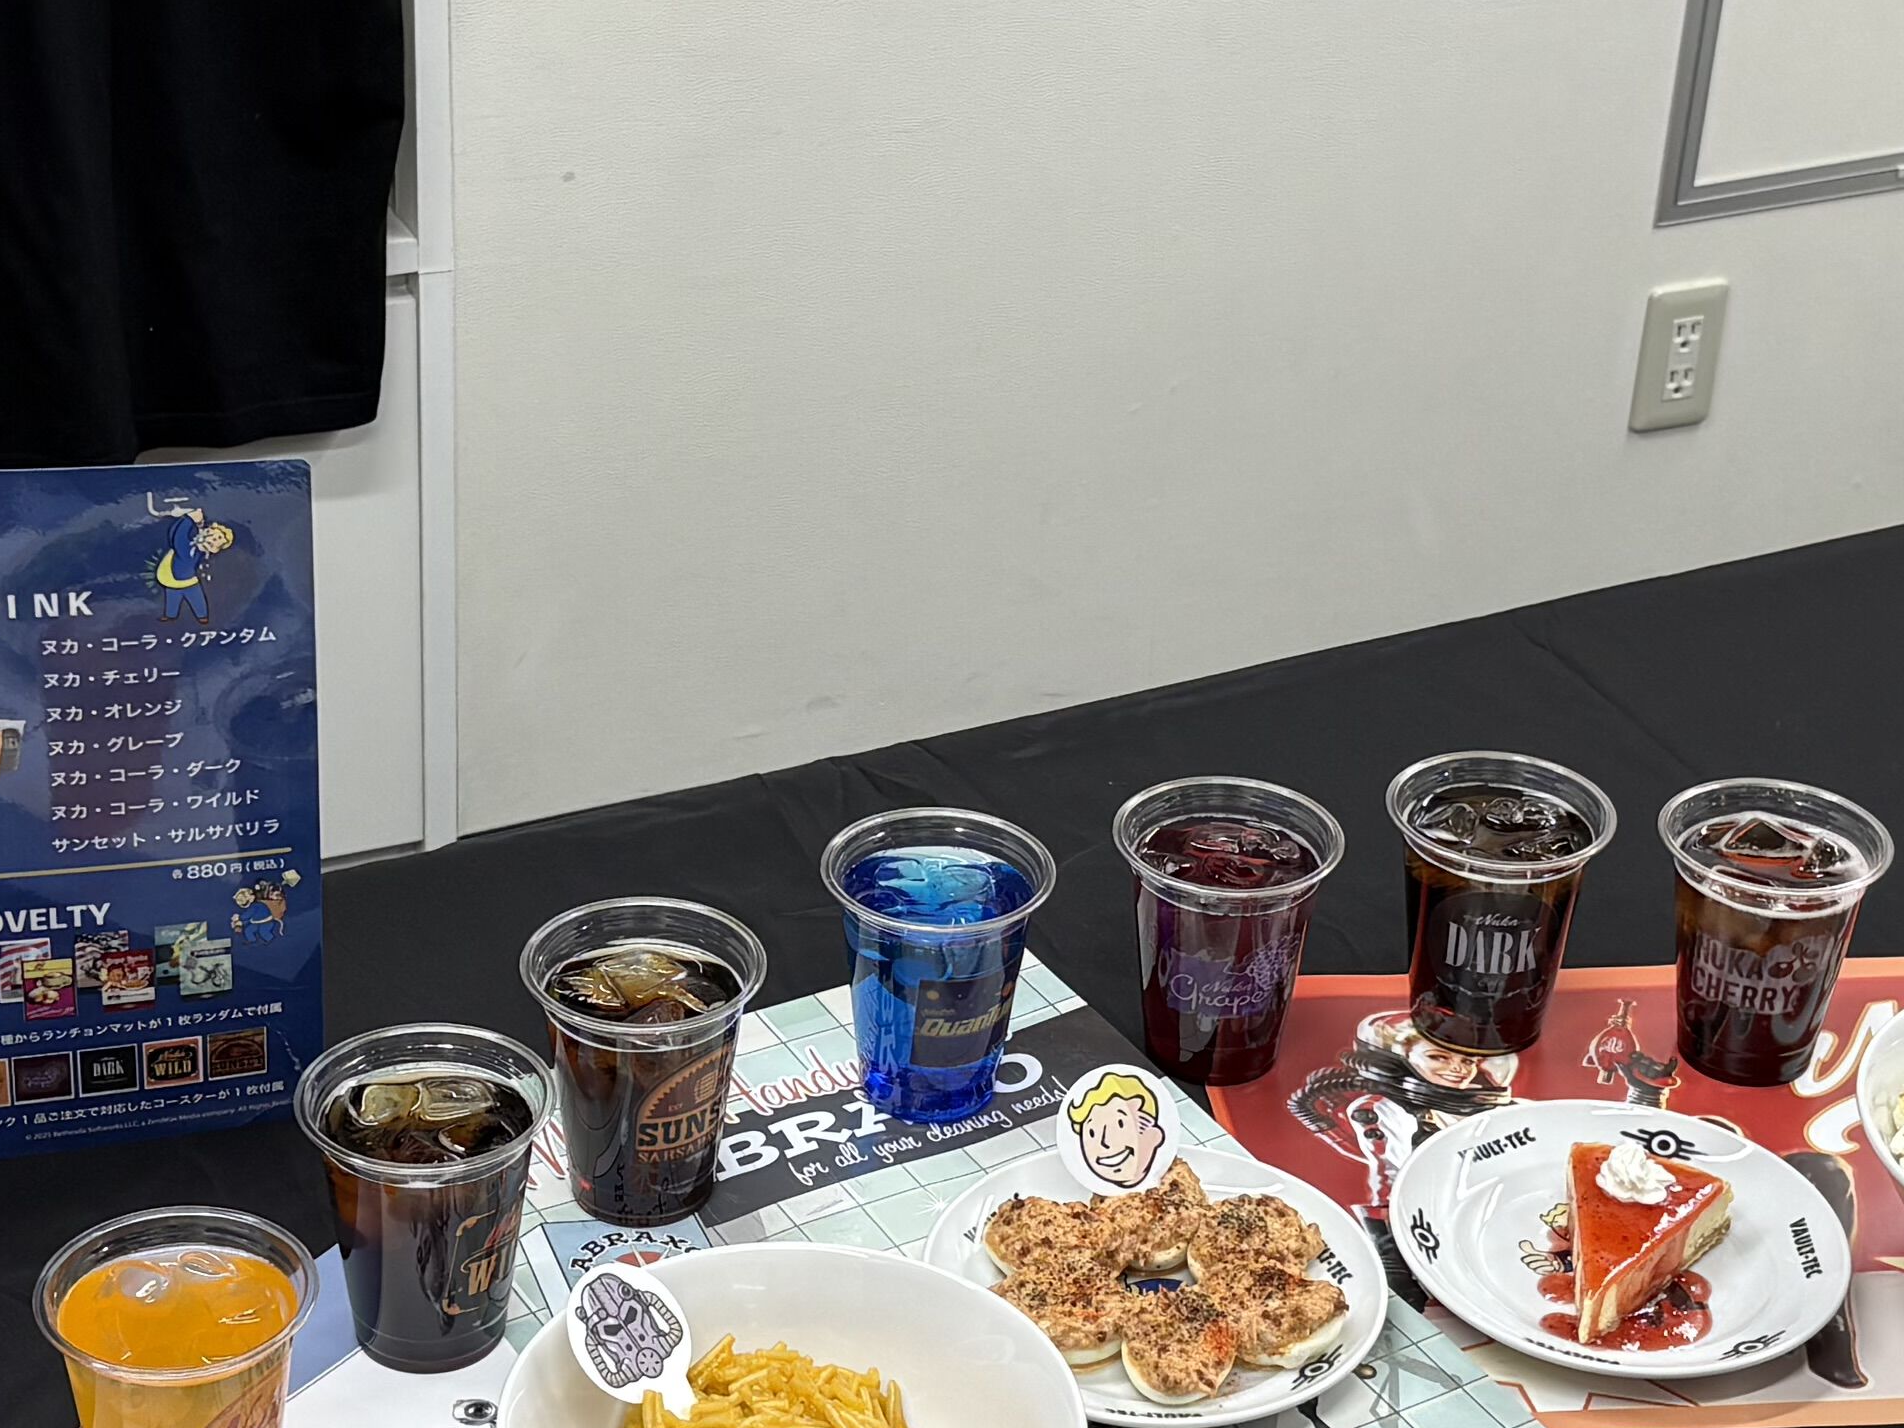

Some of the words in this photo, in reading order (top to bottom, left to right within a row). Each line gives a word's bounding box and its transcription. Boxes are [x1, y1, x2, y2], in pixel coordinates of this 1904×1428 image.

[41, 626, 277, 656] ヌカ・コーラ・クアンタム
[43, 667, 181, 690] ヌカ・チェリー
[46, 699, 183, 723] ヌカ・オレンジ
[48, 731, 185, 757] ヌカ・グレープ
[50, 757, 242, 788] ヌカ・コーラ・ダーク
[51, 789, 261, 822] ヌカ・コーラ・ワイルド
[1444, 920, 1542, 976] DARK
[1696, 932, 1766, 982] NUKA
[1170, 972, 1266, 1016] Grape
[1691, 968, 1798, 1014] CHERRY
[154, 1057, 193, 1077] WILD
[788, 1159, 831, 1188] for
[834, 1143, 867, 1169] all
[870, 1133, 924, 1167] your
[924, 1109, 1013, 1145] cleaning
[1011, 1076, 1072, 1117] needs!
[568, 1228, 703, 1274] ABRAX
